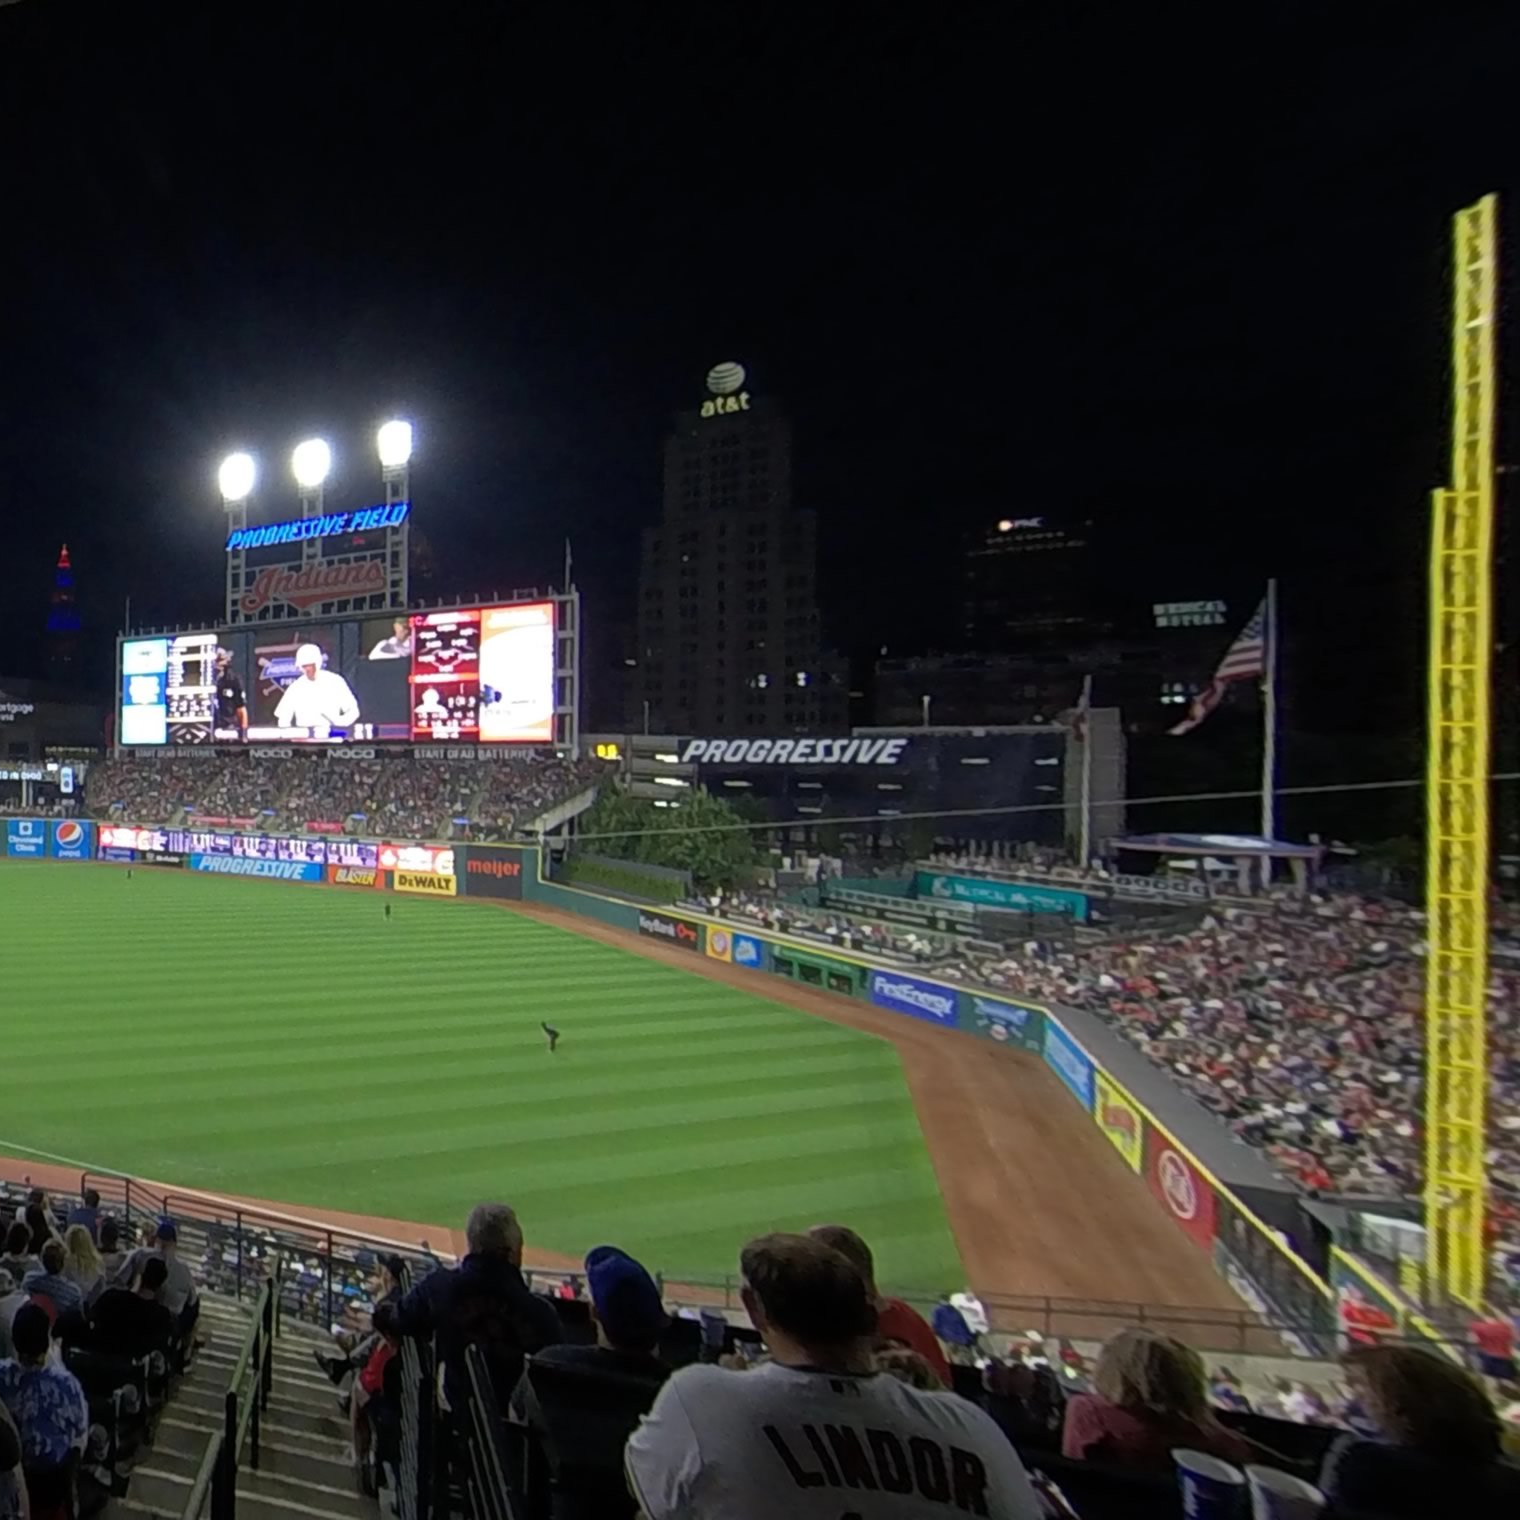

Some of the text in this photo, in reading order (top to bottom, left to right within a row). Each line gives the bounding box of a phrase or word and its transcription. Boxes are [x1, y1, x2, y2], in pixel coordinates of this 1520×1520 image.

[701, 391, 750, 418] at&t
[226, 502, 408, 550] PROGRESSIVE FIELD
[240, 558, 386, 613] Indians
[249, 748, 293, 758] NOCO
[327, 748, 375, 759] NOCO
[413, 748, 445, 759] START
[682, 738, 908, 763] PROGRESSIVE
[198, 855, 307, 880] PROGRESSIVE
[467, 858, 520, 879] meijer
[762, 1423, 991, 1518] LINDOR
